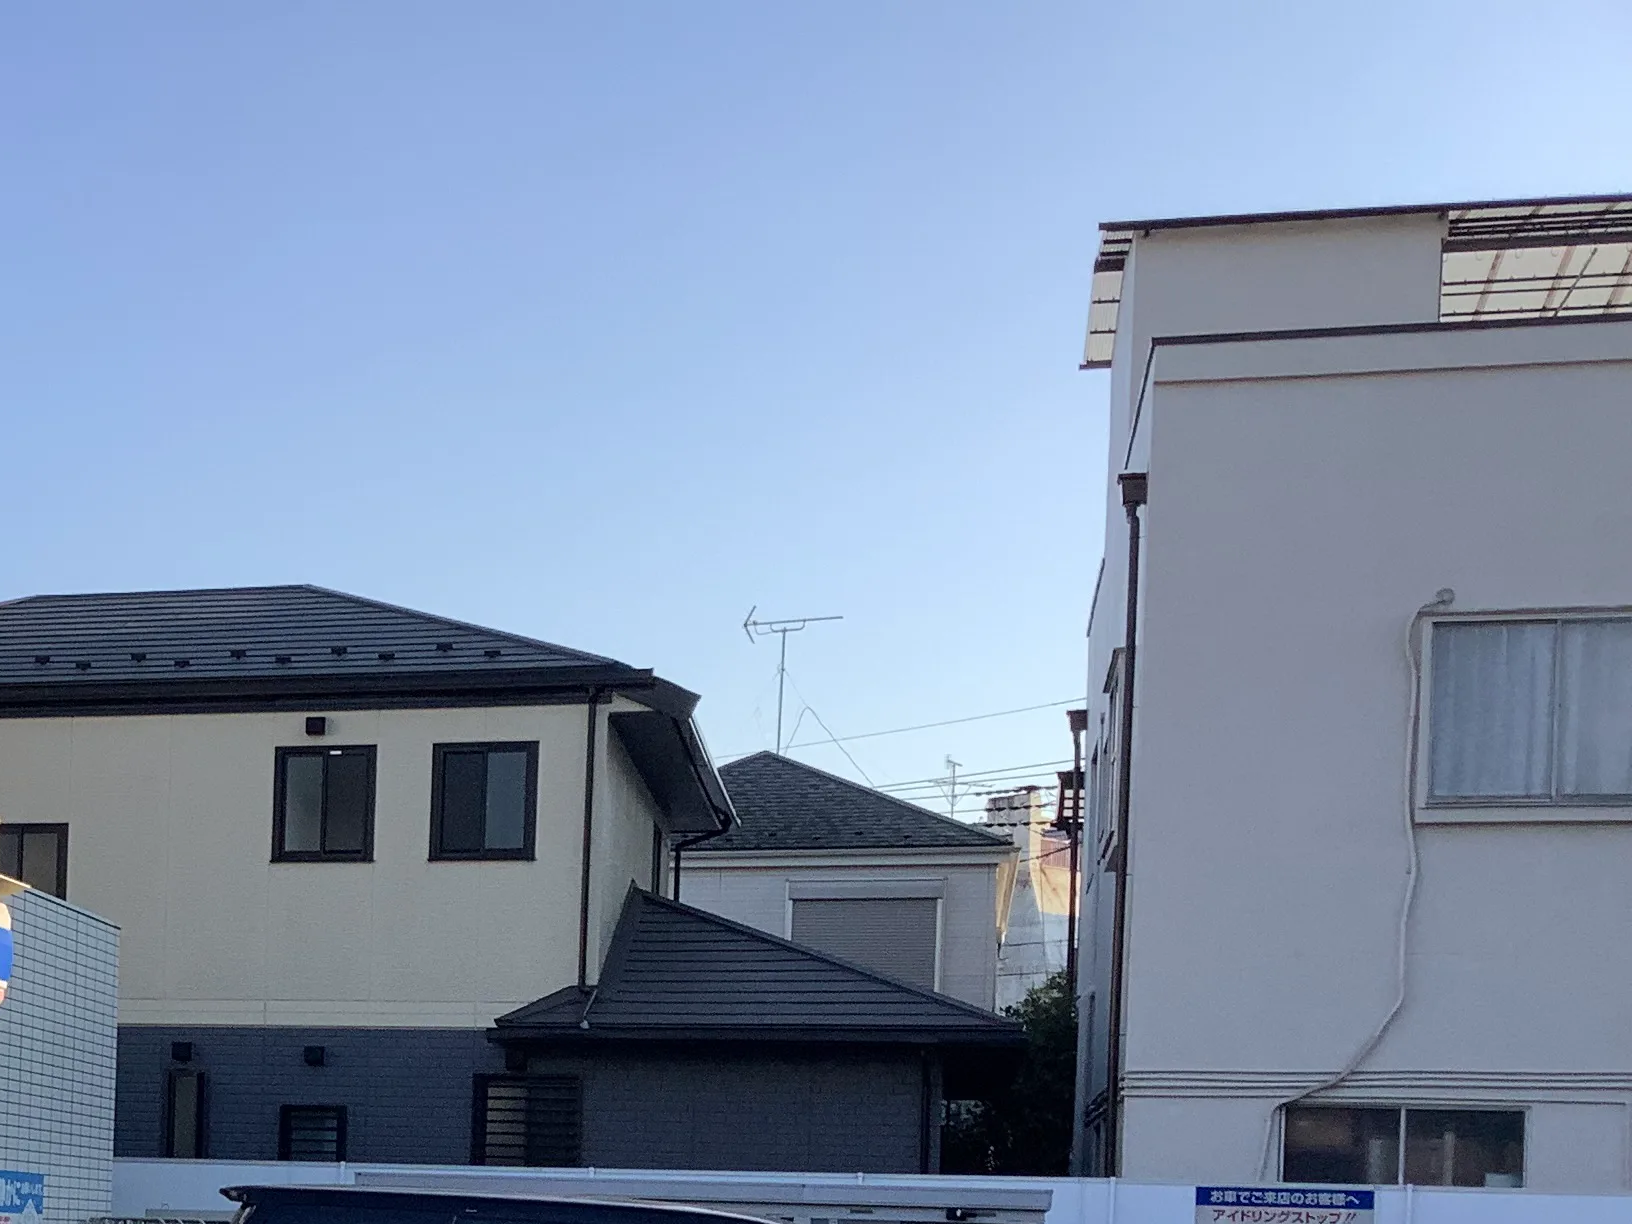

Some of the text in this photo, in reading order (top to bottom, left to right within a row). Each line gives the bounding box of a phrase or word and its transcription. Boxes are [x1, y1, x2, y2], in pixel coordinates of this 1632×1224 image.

[1210, 1191, 1360, 1207] お車でご来店のお客様へ
